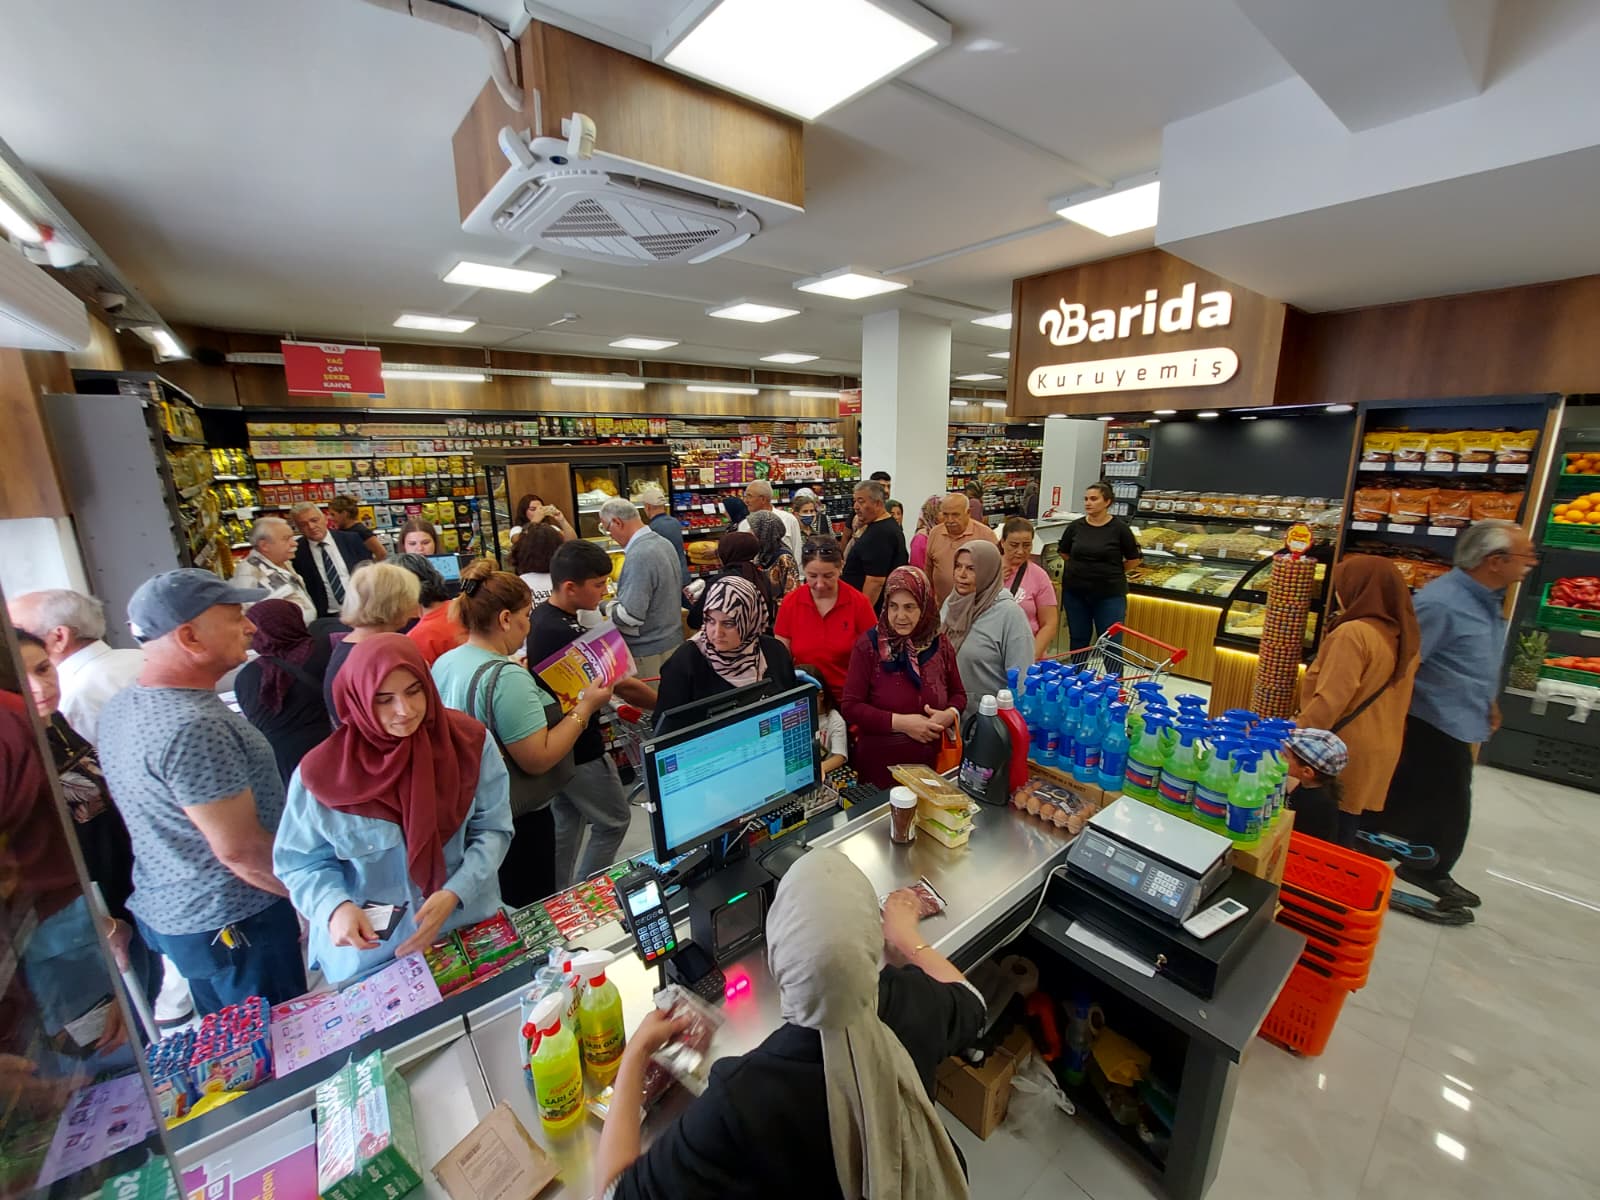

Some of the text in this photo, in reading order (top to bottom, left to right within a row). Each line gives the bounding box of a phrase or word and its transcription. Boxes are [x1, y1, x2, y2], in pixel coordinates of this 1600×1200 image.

[1039, 282, 1232, 346] Barida
[1037, 358, 1222, 389] Kuruyemiş
[356, 1055, 378, 1098] Sera
